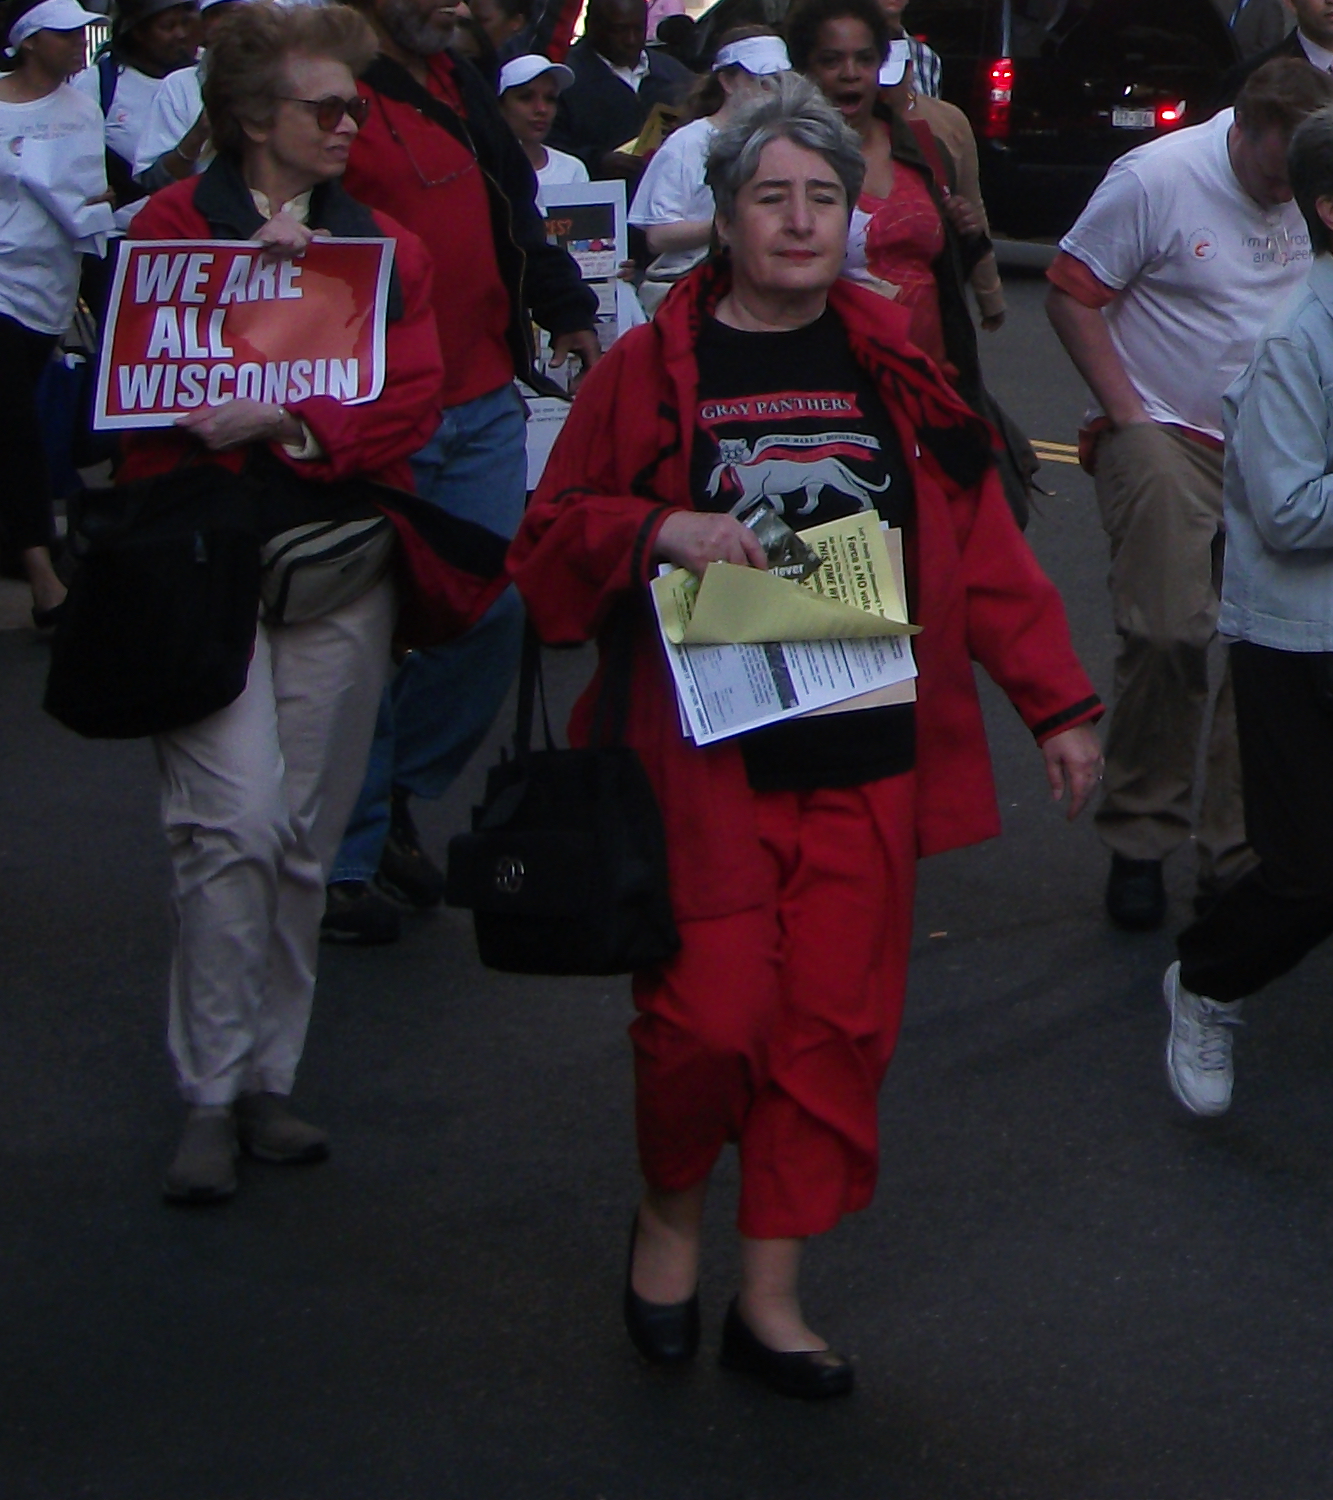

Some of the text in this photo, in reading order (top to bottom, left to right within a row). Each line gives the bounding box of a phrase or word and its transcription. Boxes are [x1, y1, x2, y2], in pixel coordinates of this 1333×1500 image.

[135, 252, 304, 304] WE ARE
[146, 306, 234, 359] ALL
[117, 358, 359, 410] WISCONSIN
[701, 397, 852, 420] GRAY PANTHERS
[817, 541, 831, 561] THIS
[847, 536, 860, 563] Force
[823, 563, 837, 585] TIME
[856, 573, 867, 588] NO
[860, 590, 871, 610] vote
